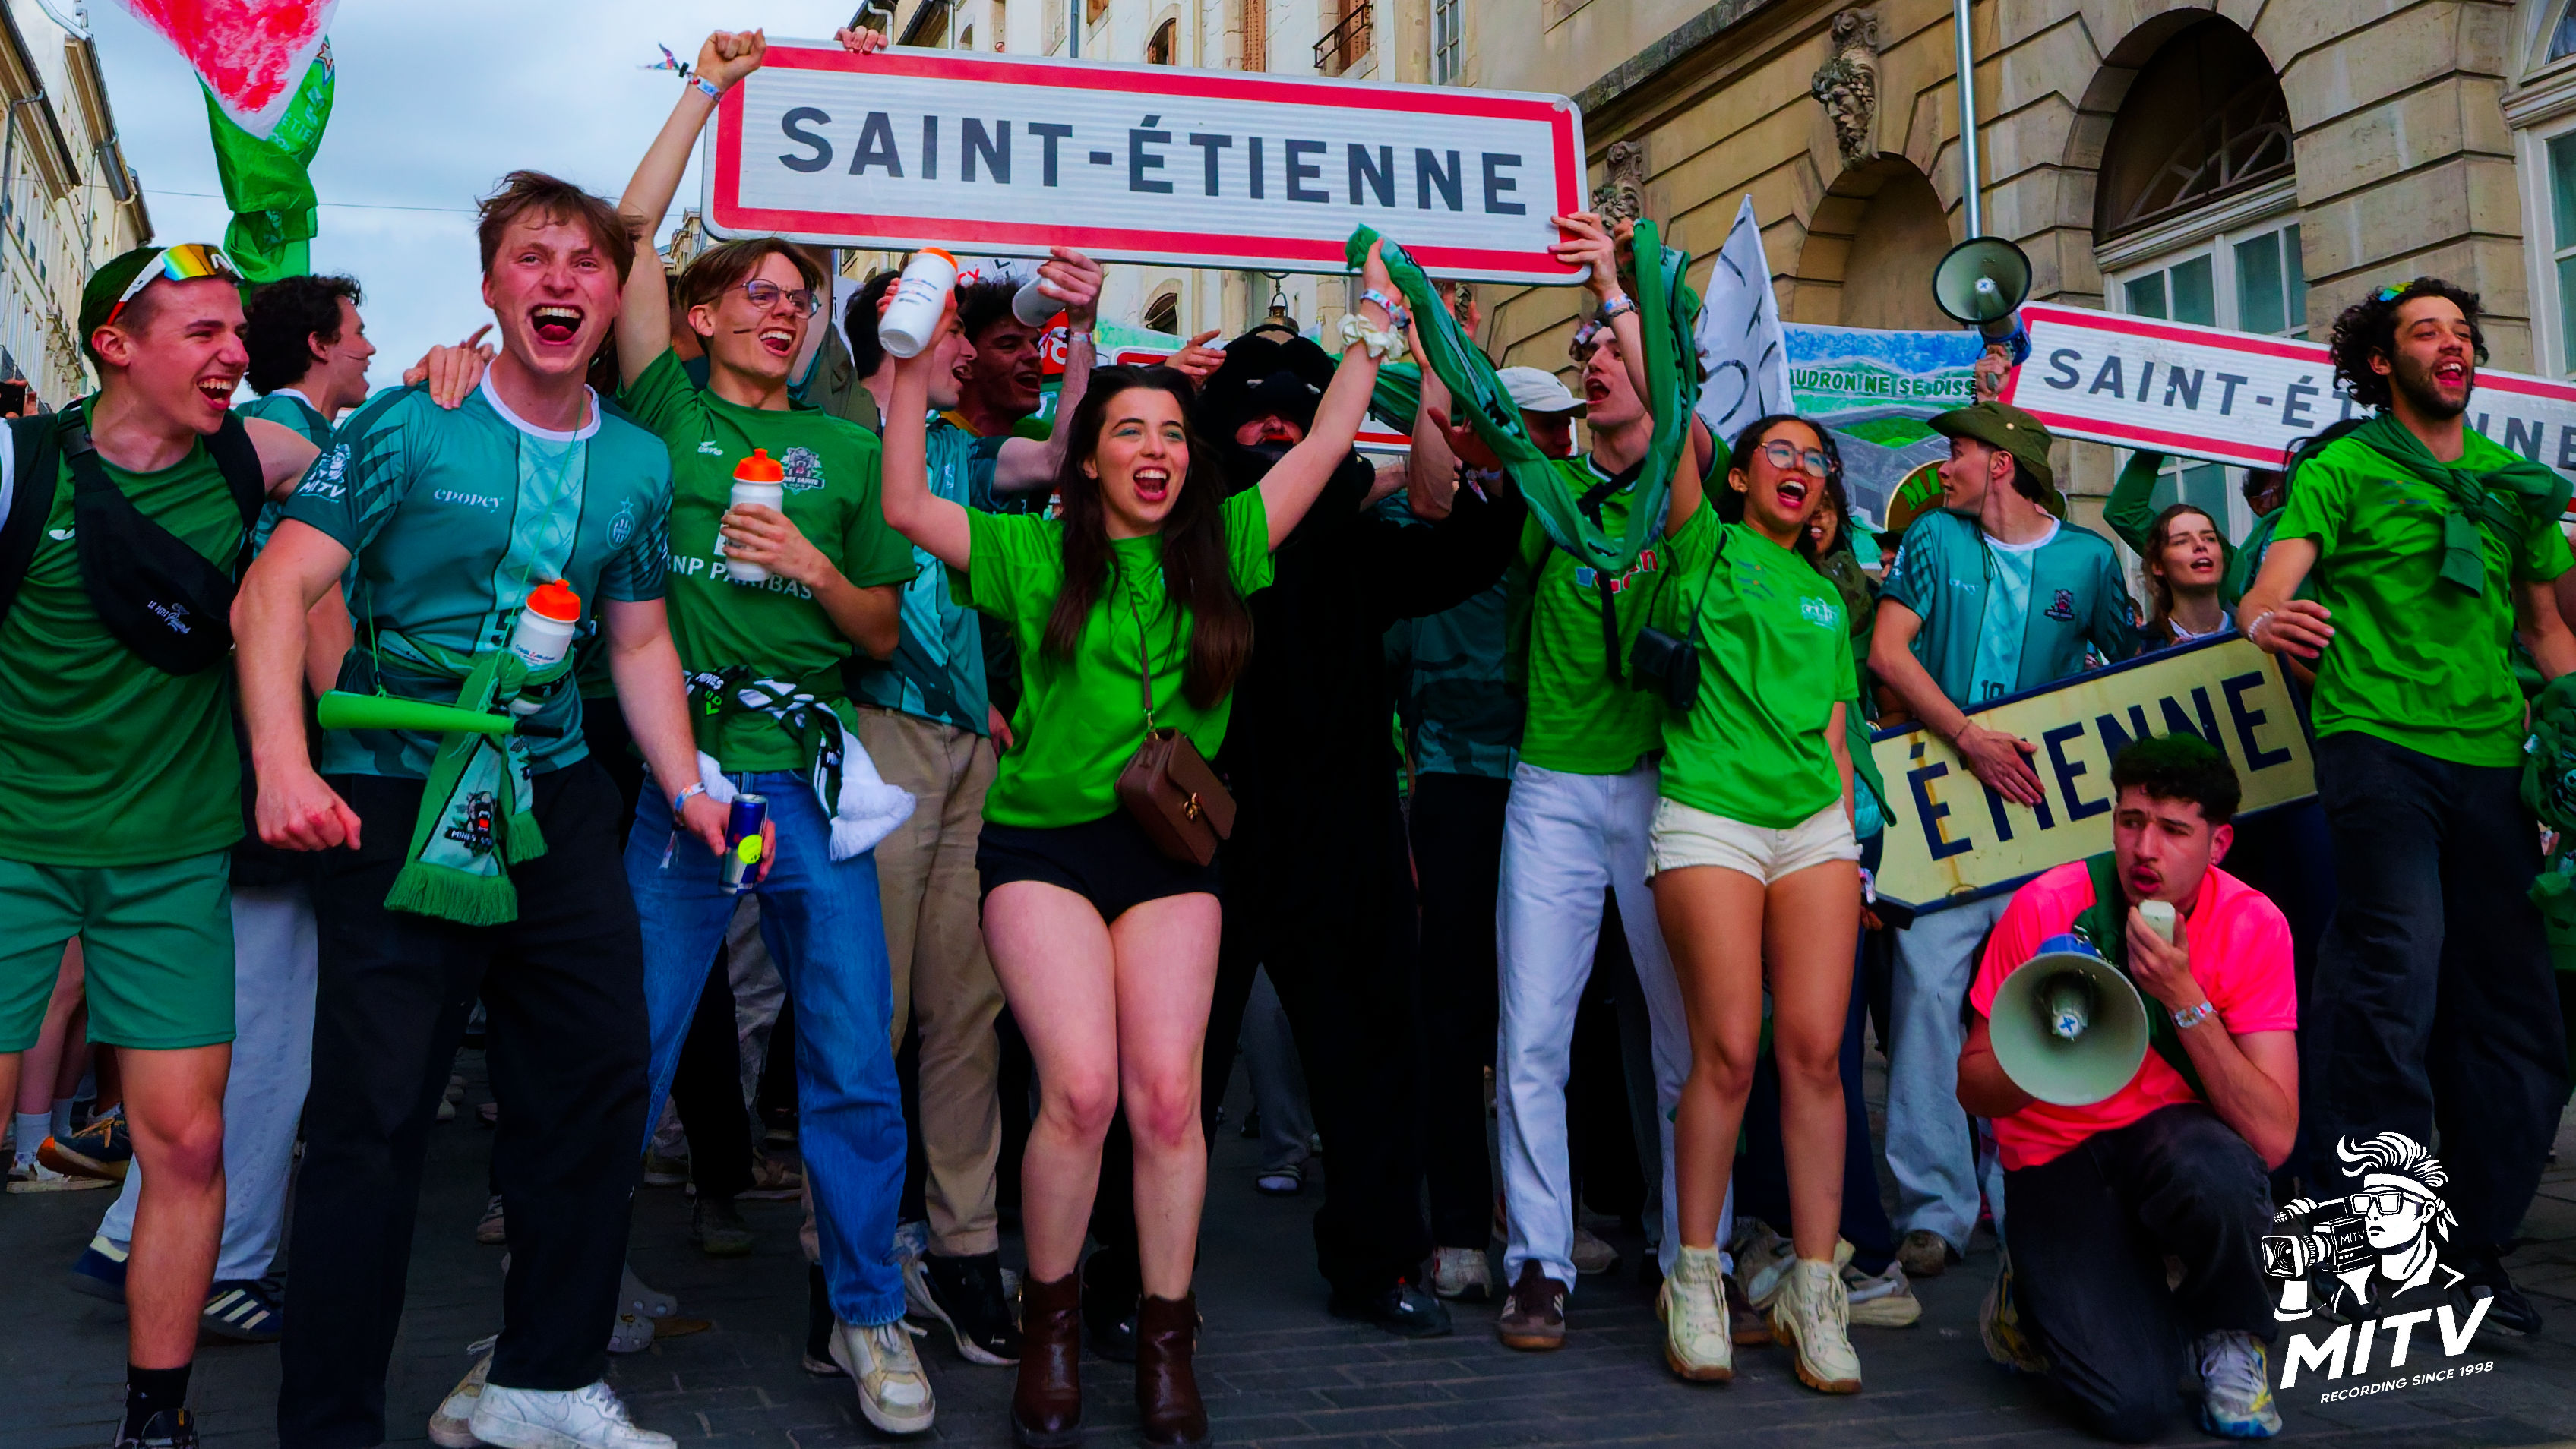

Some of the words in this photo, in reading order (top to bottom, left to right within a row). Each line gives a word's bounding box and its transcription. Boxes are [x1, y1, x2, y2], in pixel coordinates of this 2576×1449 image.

[779, 106, 1526, 216] SAINT-ÉTIENNE
[1865, 376, 1890, 393] NE
[1899, 378, 1925, 395] SE
[2043, 347, 2576, 470] SAINT-ÉTNE
[710, 561, 813, 600] PIBAS
